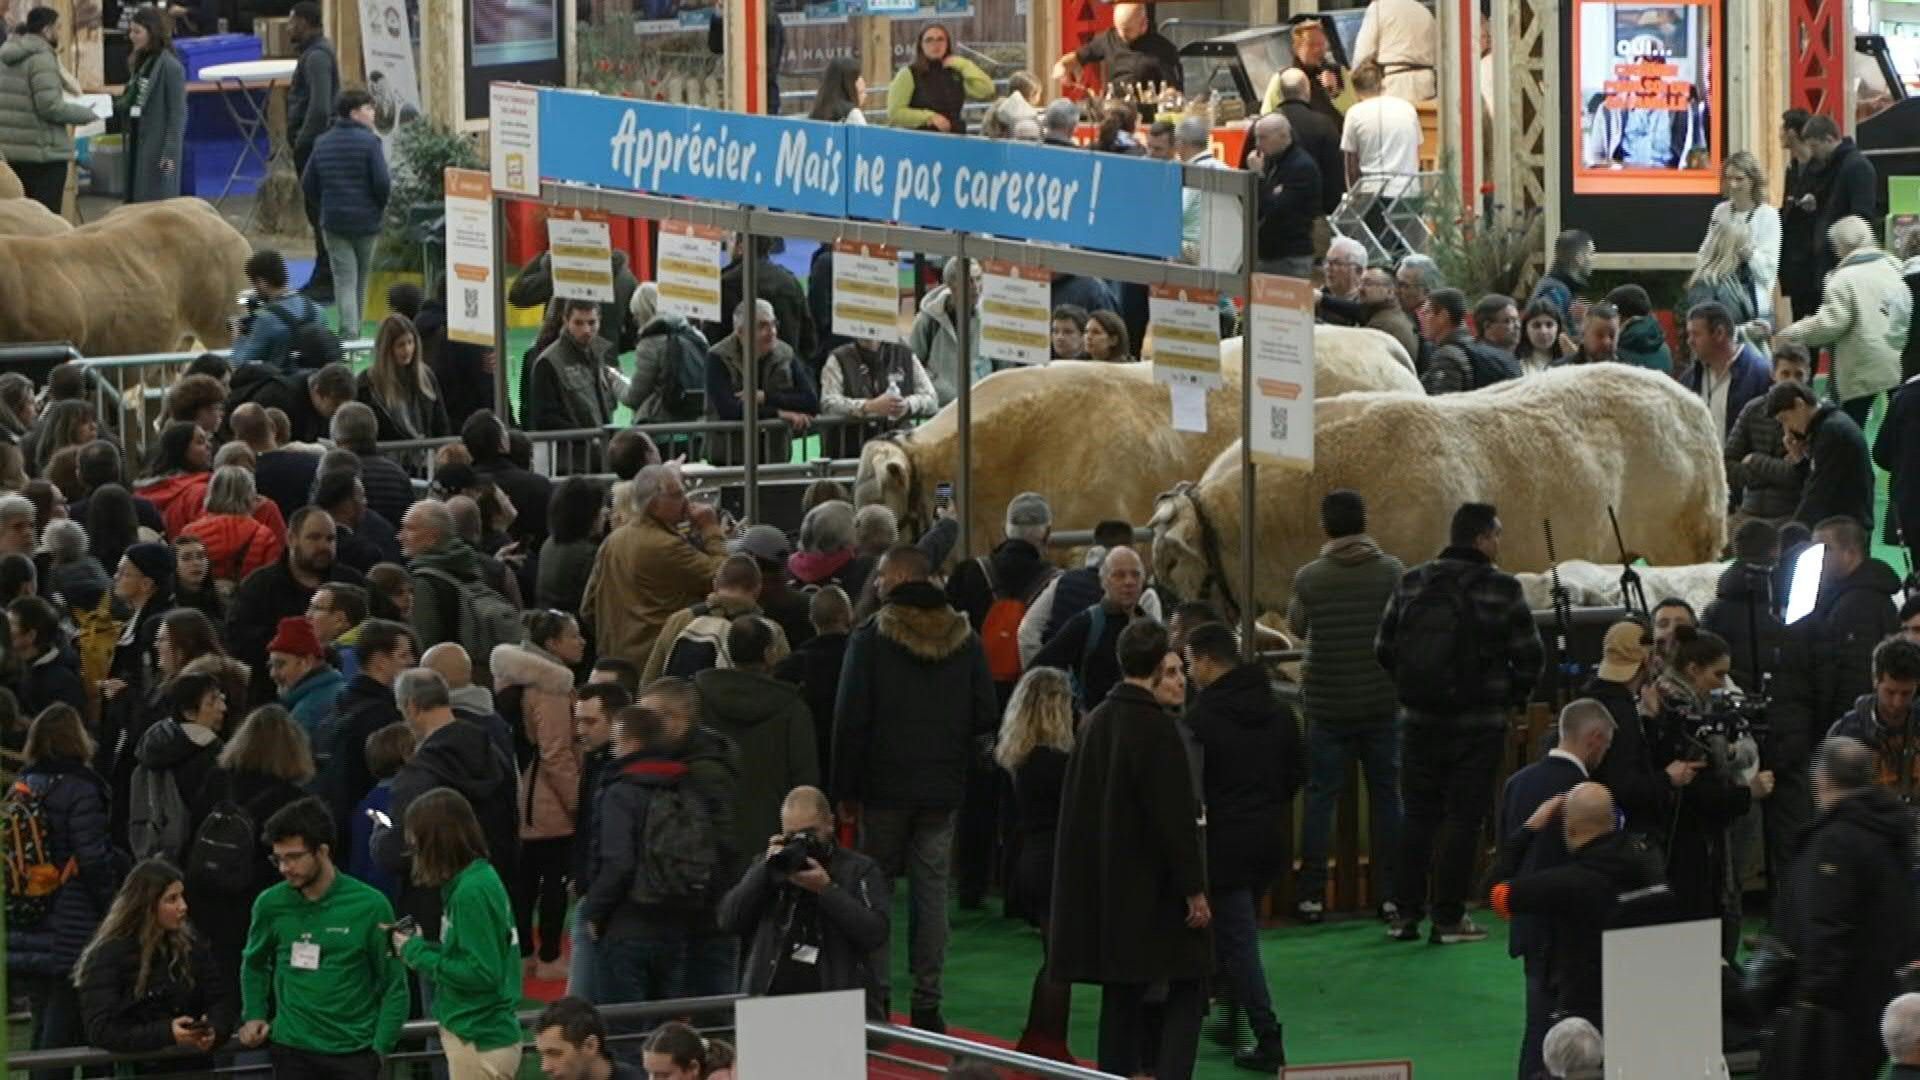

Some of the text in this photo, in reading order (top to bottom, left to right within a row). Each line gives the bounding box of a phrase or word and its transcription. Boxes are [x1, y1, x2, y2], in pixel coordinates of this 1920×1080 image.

[610, 108, 762, 191] Apprécier.
[775, 128, 843, 196] Mais
[854, 153, 885, 196] ne
[893, 157, 943, 221] pas
[954, 165, 1078, 222] caresser
